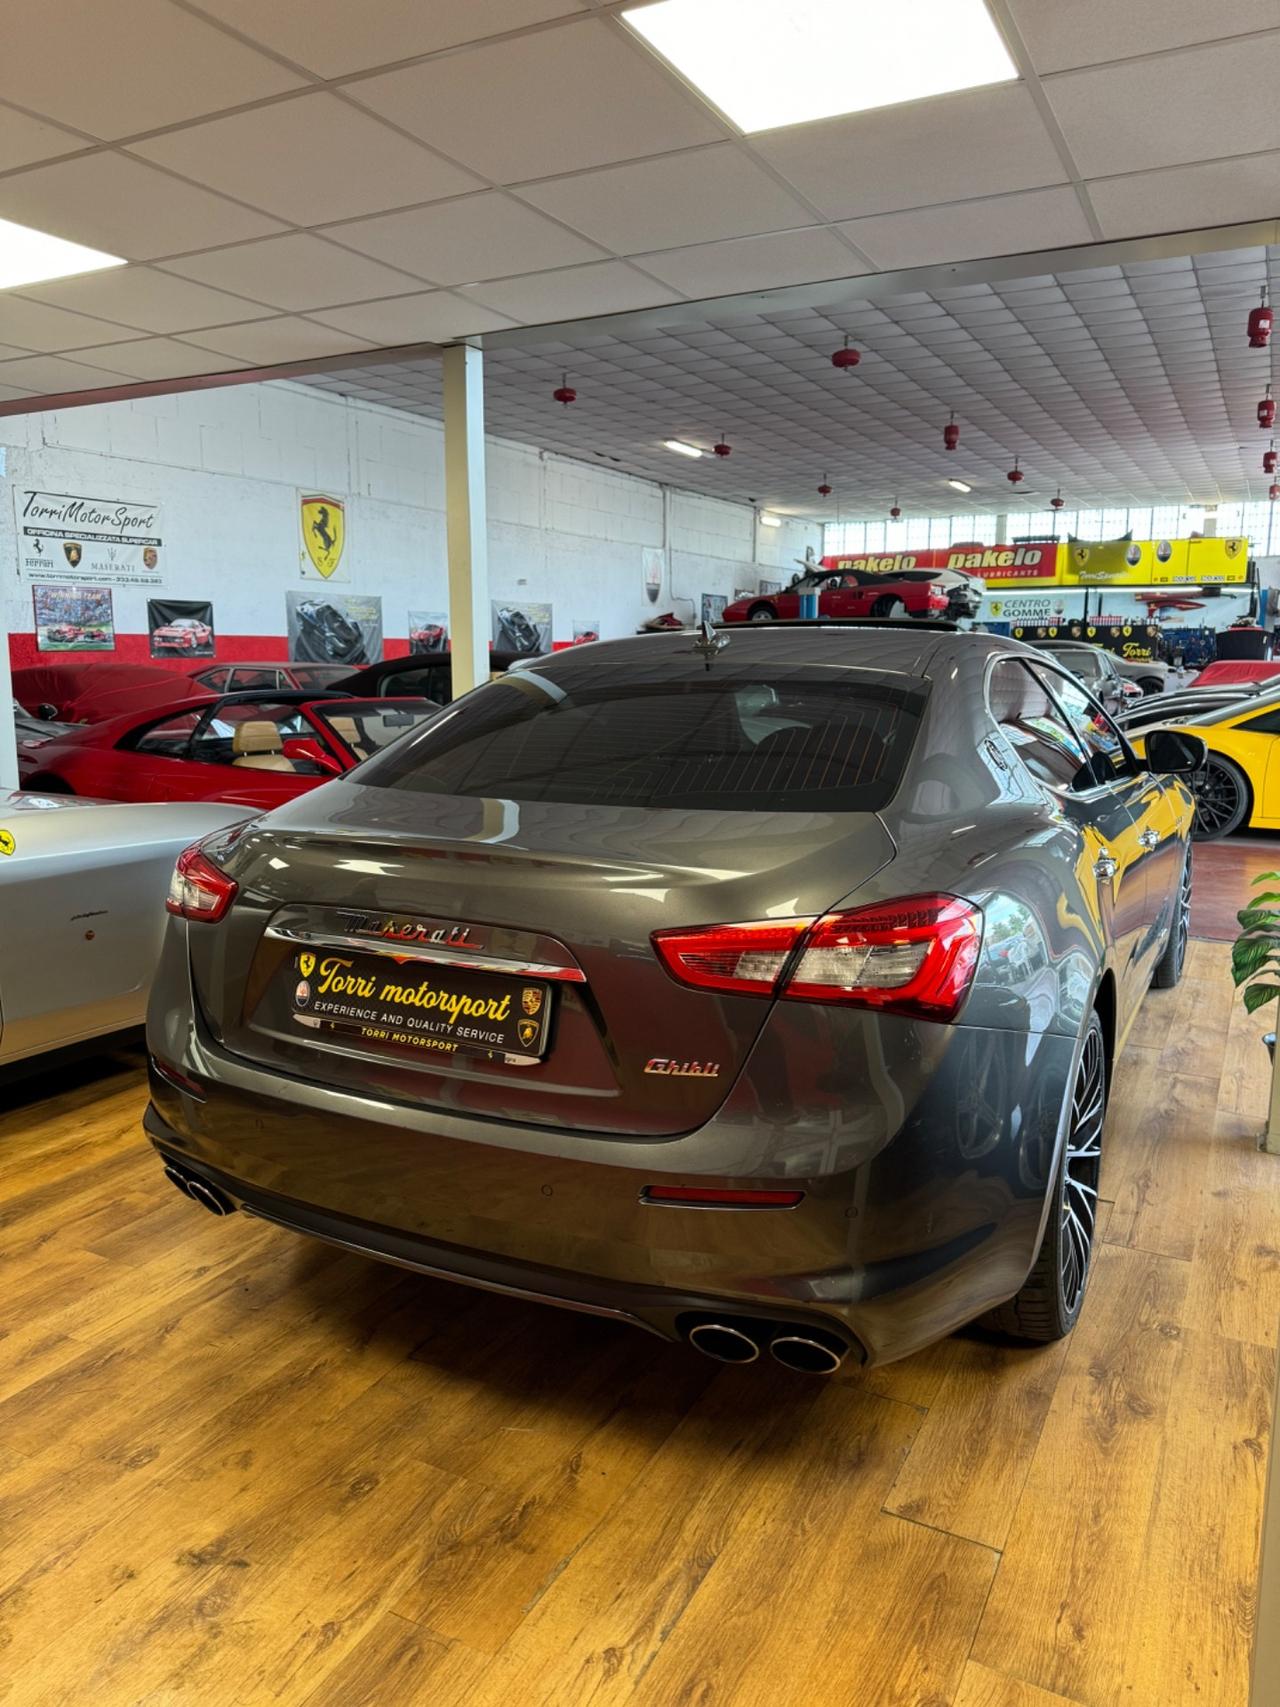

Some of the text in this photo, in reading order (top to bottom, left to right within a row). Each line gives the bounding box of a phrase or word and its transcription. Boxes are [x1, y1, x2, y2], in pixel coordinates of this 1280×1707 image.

[23, 491, 158, 533] TorriMotorSport
[947, 548, 1042, 569] pakelo
[1003, 608, 1050, 617] GOMME
[1004, 599, 1050, 608] CENTRO
[317, 957, 512, 1023] Torri motorsport
[313, 1001, 505, 1044] EXPERIENCE AND QUALITY SERVICE
[361, 1027, 459, 1052] TORRI MOTORSPORT
[644, 1058, 720, 1077] Ghibli
